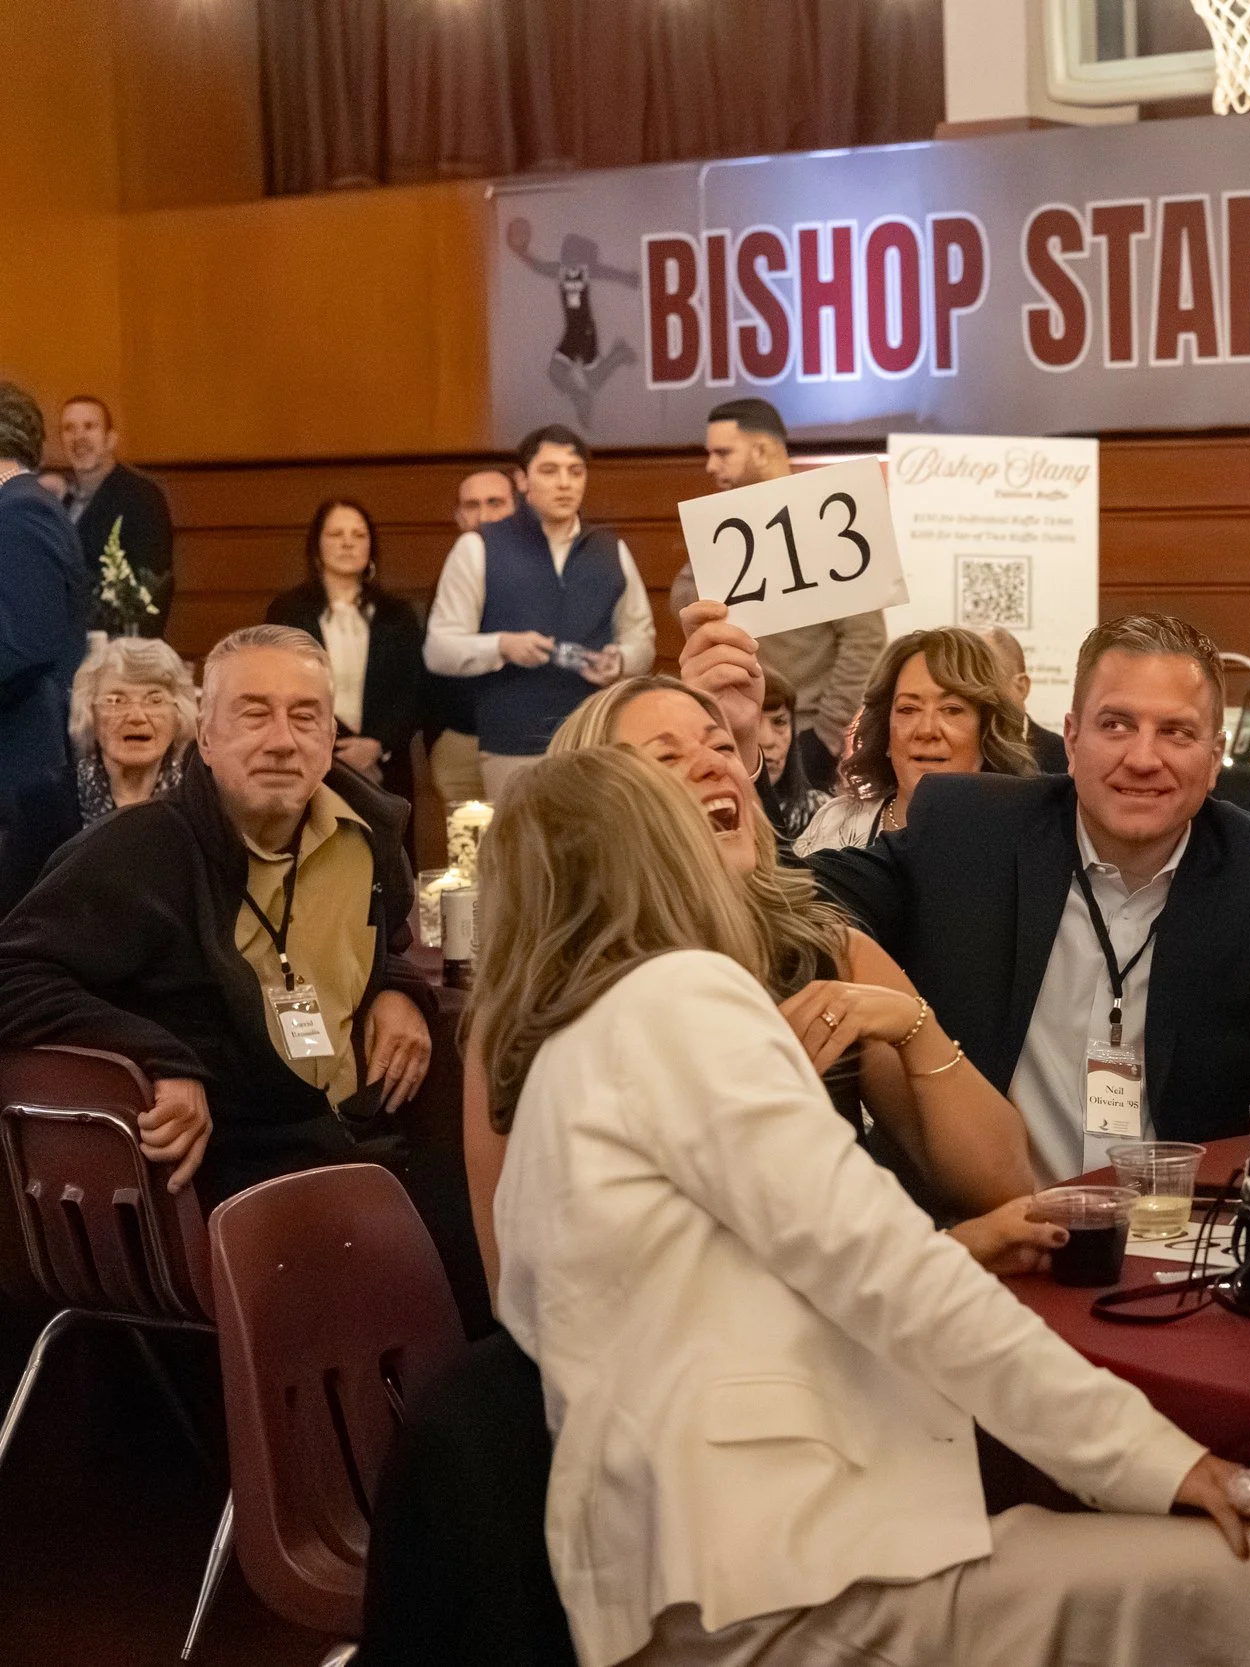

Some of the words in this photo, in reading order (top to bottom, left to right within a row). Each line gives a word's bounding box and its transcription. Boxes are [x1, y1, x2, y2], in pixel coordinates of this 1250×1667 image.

[641, 211, 990, 391] BISHOP
[897, 445, 999, 486] Bishop
[1004, 446, 1091, 489] Stang
[712, 491, 871, 607] 213
[1089, 1096, 1124, 1108] Oliveira
[1105, 1085, 1124, 1095] Neil
